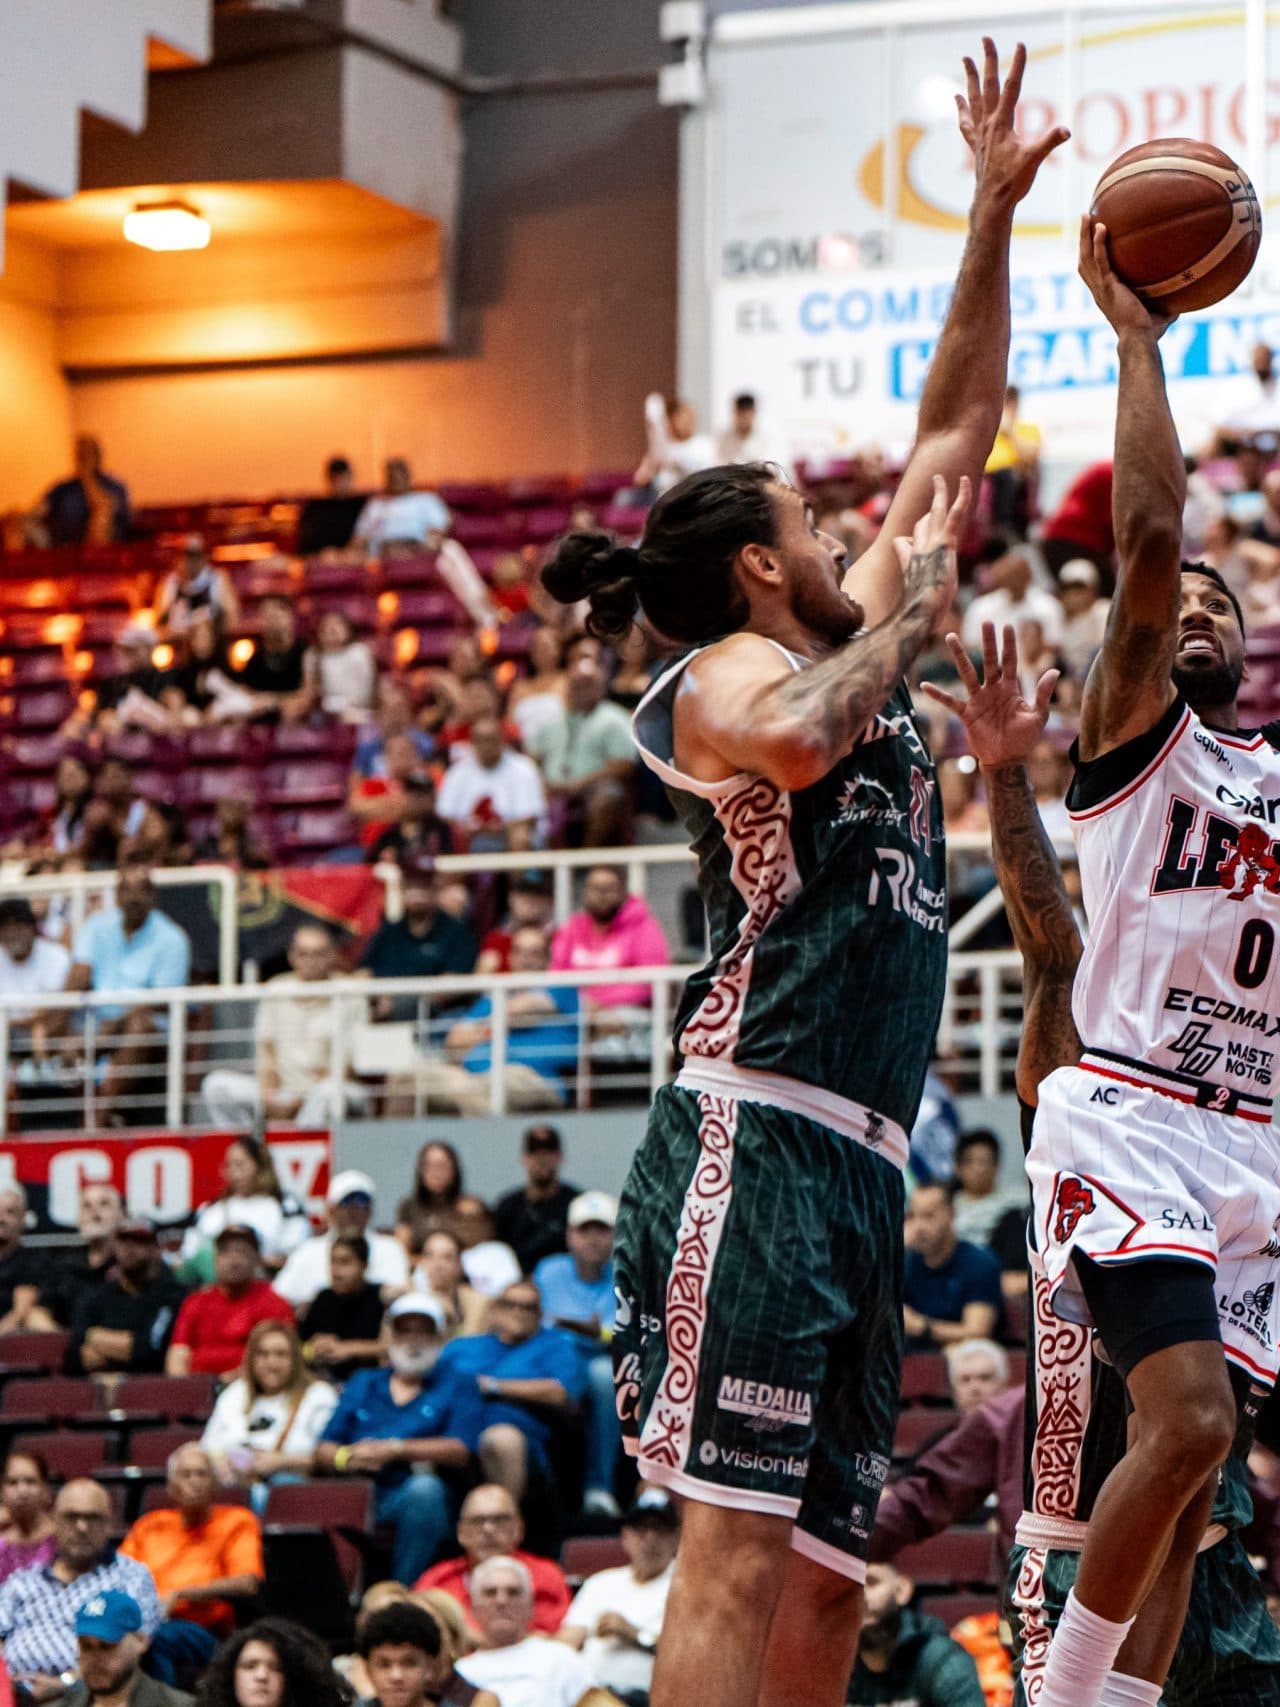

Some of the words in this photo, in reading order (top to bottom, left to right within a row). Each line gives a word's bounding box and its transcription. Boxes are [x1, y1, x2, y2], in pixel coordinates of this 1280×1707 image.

[720, 230, 888, 278] SOMS
[735, 301, 780, 332] EL
[796, 355, 862, 398] TU
[1233, 917, 1275, 989] 0
[1090, 1087, 1120, 1106] AC
[719, 1375, 811, 1417] MEDALLA
